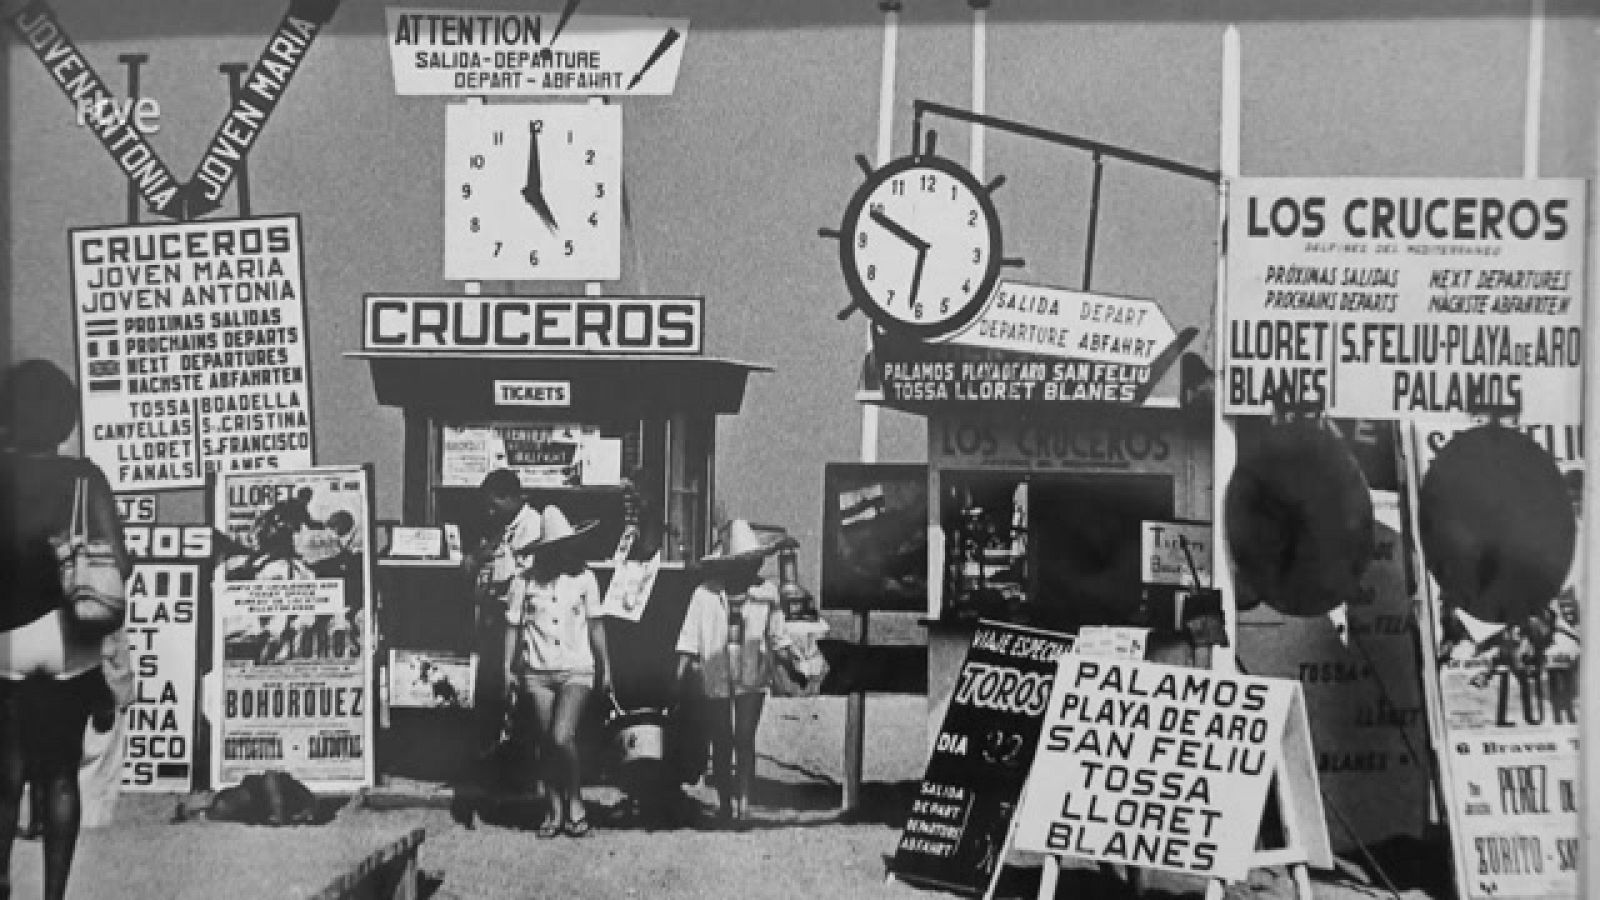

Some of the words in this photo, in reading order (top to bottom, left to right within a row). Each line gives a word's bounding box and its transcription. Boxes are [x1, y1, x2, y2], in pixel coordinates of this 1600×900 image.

[394, 14, 542, 46] ATTENTION
[18, 12, 98, 102] JOVEN
[199, 99, 264, 201] JOVEN
[249, 16, 316, 101] MARIA
[1247, 196, 1326, 238] LOS
[1343, 197, 1570, 241] CRUCEROS
[80, 226, 291, 265] CRUCEROS
[86, 262, 182, 289] JOVEN
[193, 256, 285, 282] MARIA
[1339, 266, 1400, 288] SALIDAS
[1429, 269, 1473, 289] NEXT
[1475, 269, 1573, 291] DEPARTURES
[82, 286, 172, 314] JOVEN
[181, 278, 297, 307] ANTONIA
[996, 291, 1060, 316] SALIDA
[1079, 301, 1148, 326] DEPART
[210, 306, 281, 329] SALIDAS
[371, 301, 696, 347] CRUCEROS
[126, 331, 218, 354] PROCHAINS
[223, 326, 299, 349] DEPARTS
[978, 319, 1070, 349] DEPARTURE
[1077, 332, 1157, 359] ABFAHRT
[1231, 320, 1330, 361] LLORET
[1535, 326, 1583, 368] ARO
[127, 355, 169, 374] NEXT
[180, 347, 288, 371] DEPARTURES
[209, 365, 304, 390] ABFAHRTEN
[884, 361, 955, 381] PALAMOS
[1053, 361, 1091, 381] SAN
[1094, 362, 1151, 384] FELIU
[201, 390, 302, 414] BOADELLA
[499, 385, 566, 401] TICKETS
[893, 381, 948, 400] TOSSA
[954, 381, 1036, 400] LLORET
[1044, 382, 1137, 401] BLANES
[1229, 366, 1328, 406] BLANES
[1392, 369, 1522, 412] PALAMOS
[129, 399, 191, 420] TOSSA
[117, 440, 191, 462] LLORET
[119, 460, 193, 483] FANALS
[954, 661, 1058, 716] TOROS
[1074, 661, 1270, 712] PALAMOS
[1059, 692, 1151, 731] PLAYA
[1158, 705, 1201, 737] DE
[1204, 712, 1270, 745] ARO
[936, 732, 969, 756] DIA
[1045, 724, 1136, 761] SAN
[1148, 736, 1268, 776] FELIU
[1079, 760, 1212, 805] TOSSA
[1060, 791, 1223, 838] LLORET
[1045, 821, 1220, 872] BLANES
